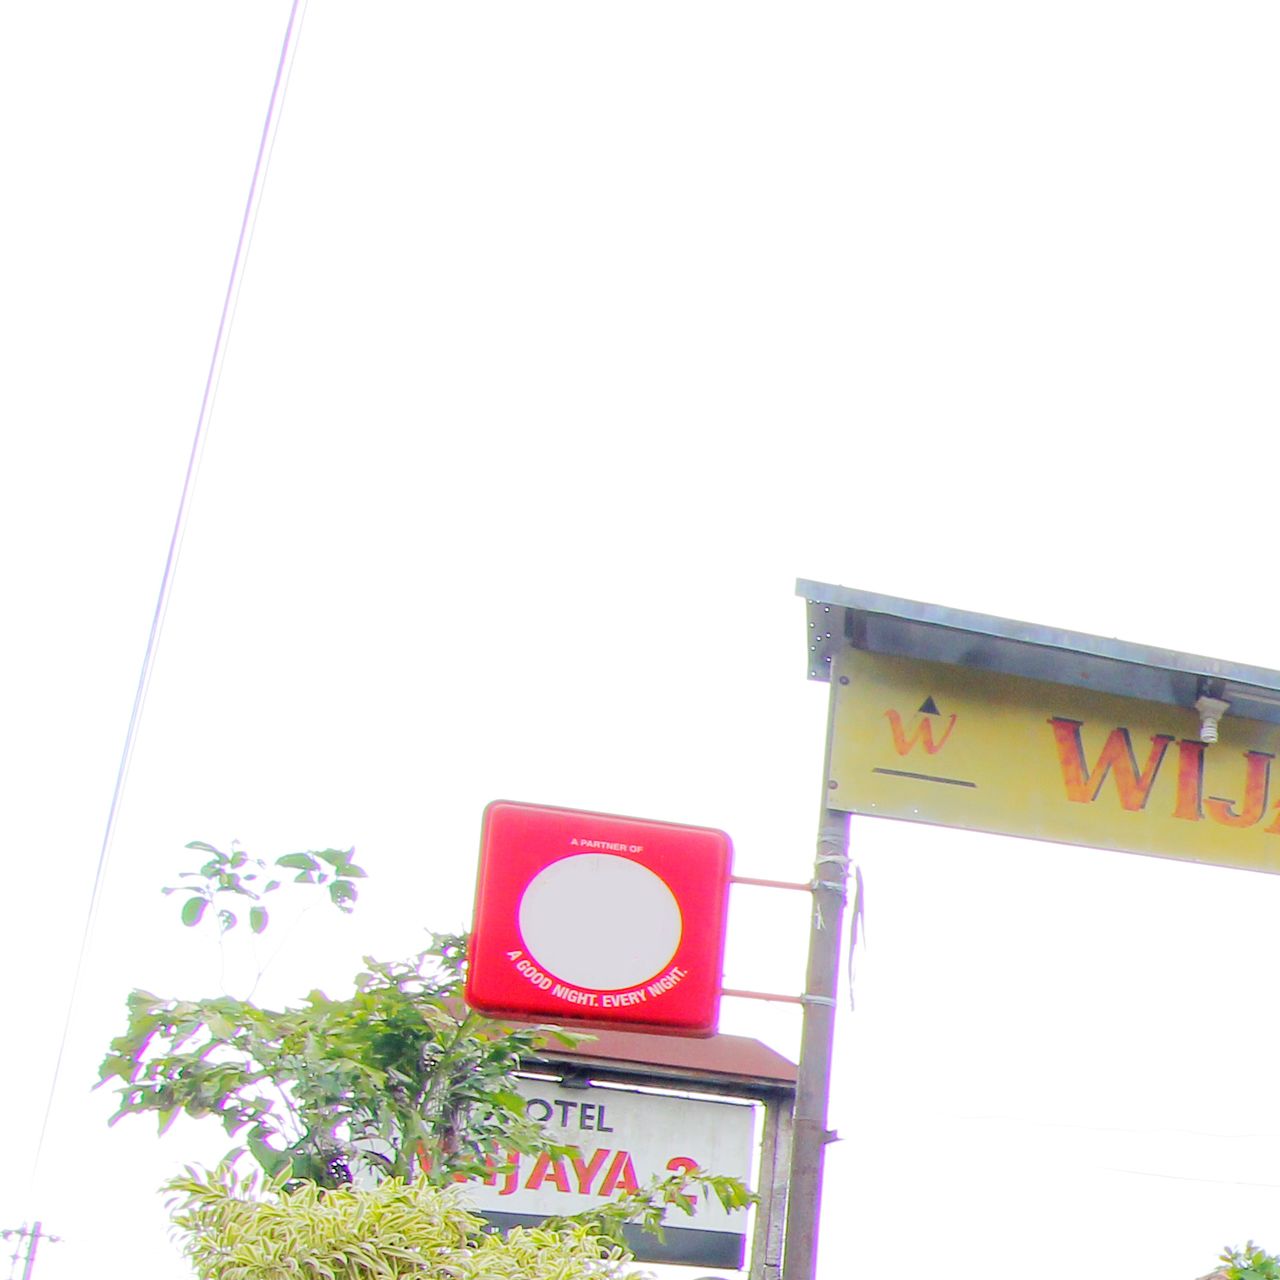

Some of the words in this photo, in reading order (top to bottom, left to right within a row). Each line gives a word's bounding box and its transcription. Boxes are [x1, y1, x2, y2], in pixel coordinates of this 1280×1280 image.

[570, 838, 579, 847] A
[580, 839, 628, 852] PARTNER
[629, 844, 644, 854] OF
[507, 950, 523, 960] A
[516, 959, 552, 991] GOOD
[552, 984, 599, 1007] NIGHT.
[602, 990, 647, 1008] EVERY
[649, 966, 688, 998] NIGHT.
[526, 1098, 614, 1133] OTEL
